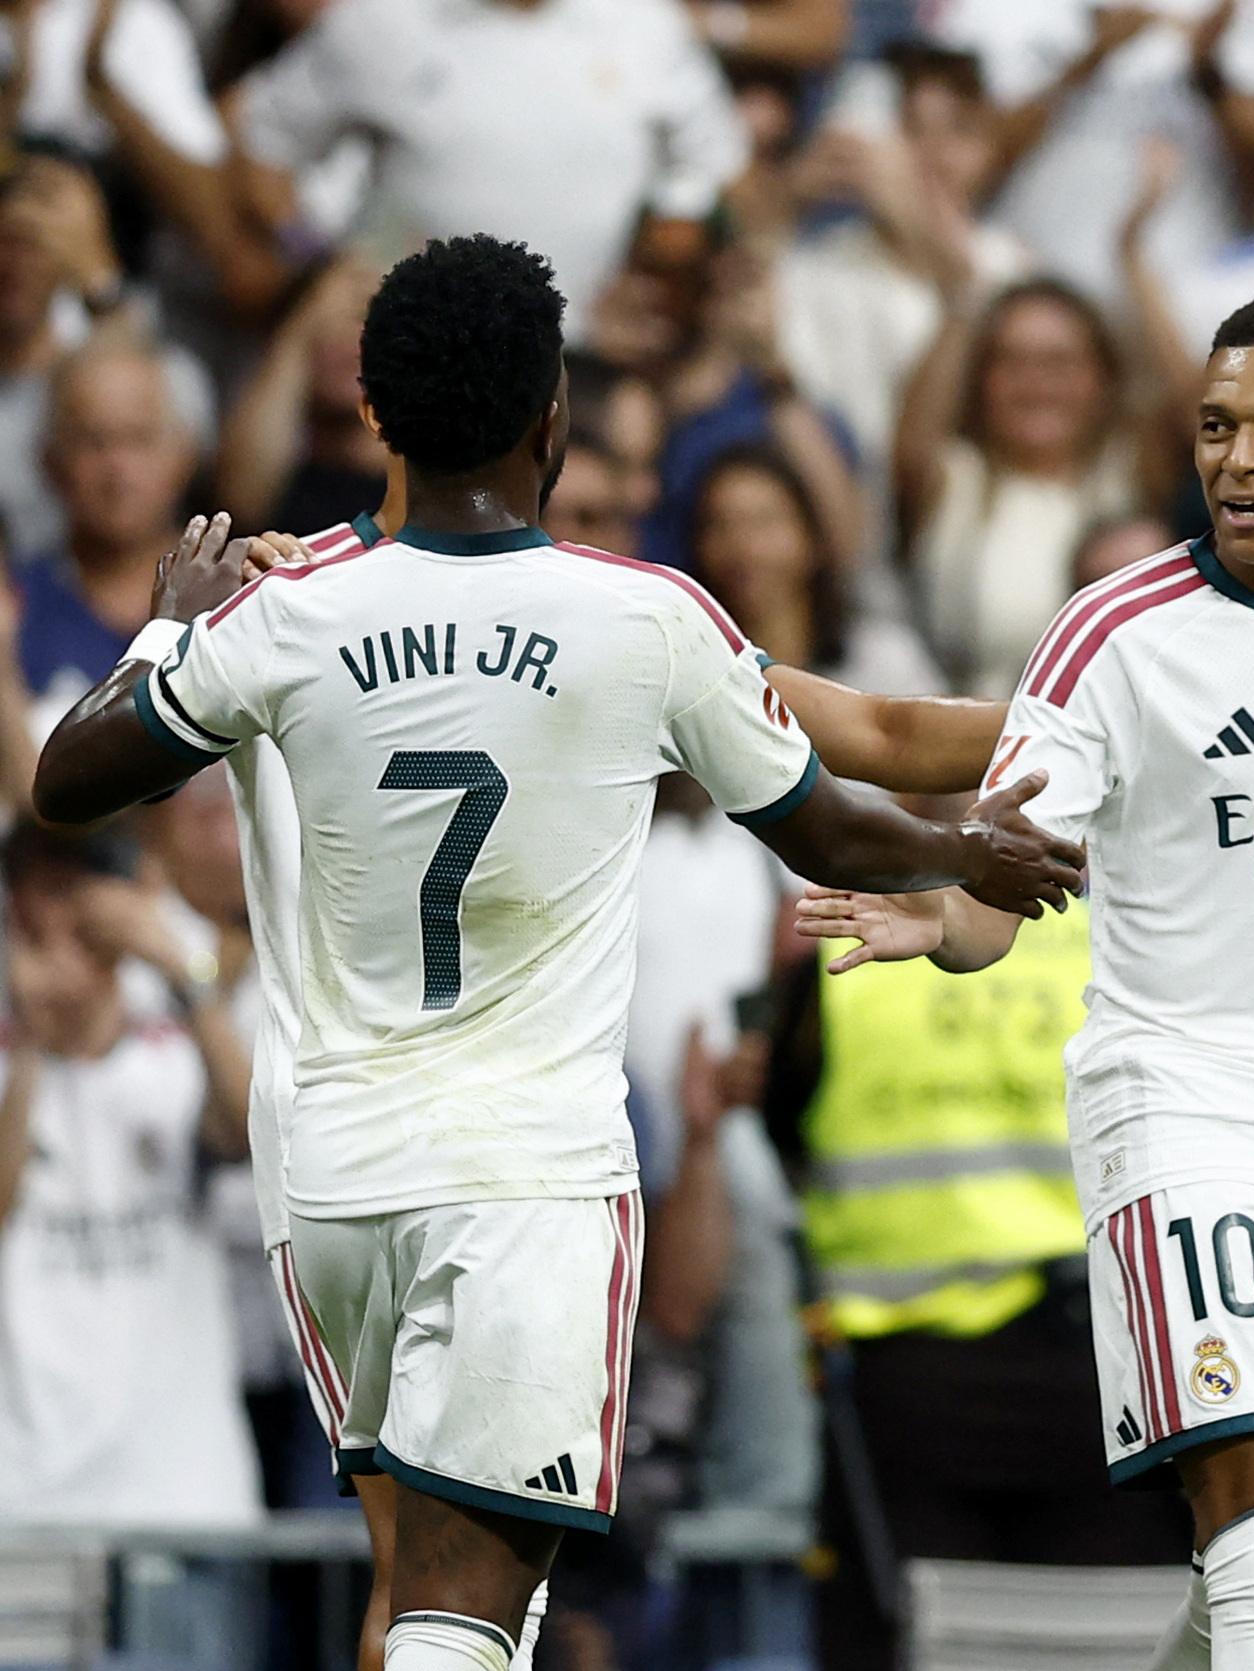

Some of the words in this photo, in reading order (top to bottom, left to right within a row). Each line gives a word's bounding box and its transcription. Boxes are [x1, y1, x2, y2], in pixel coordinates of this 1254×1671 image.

[338, 623, 456, 693] VINI
[476, 624, 558, 697] JR.
[376, 750, 509, 1011] 7
